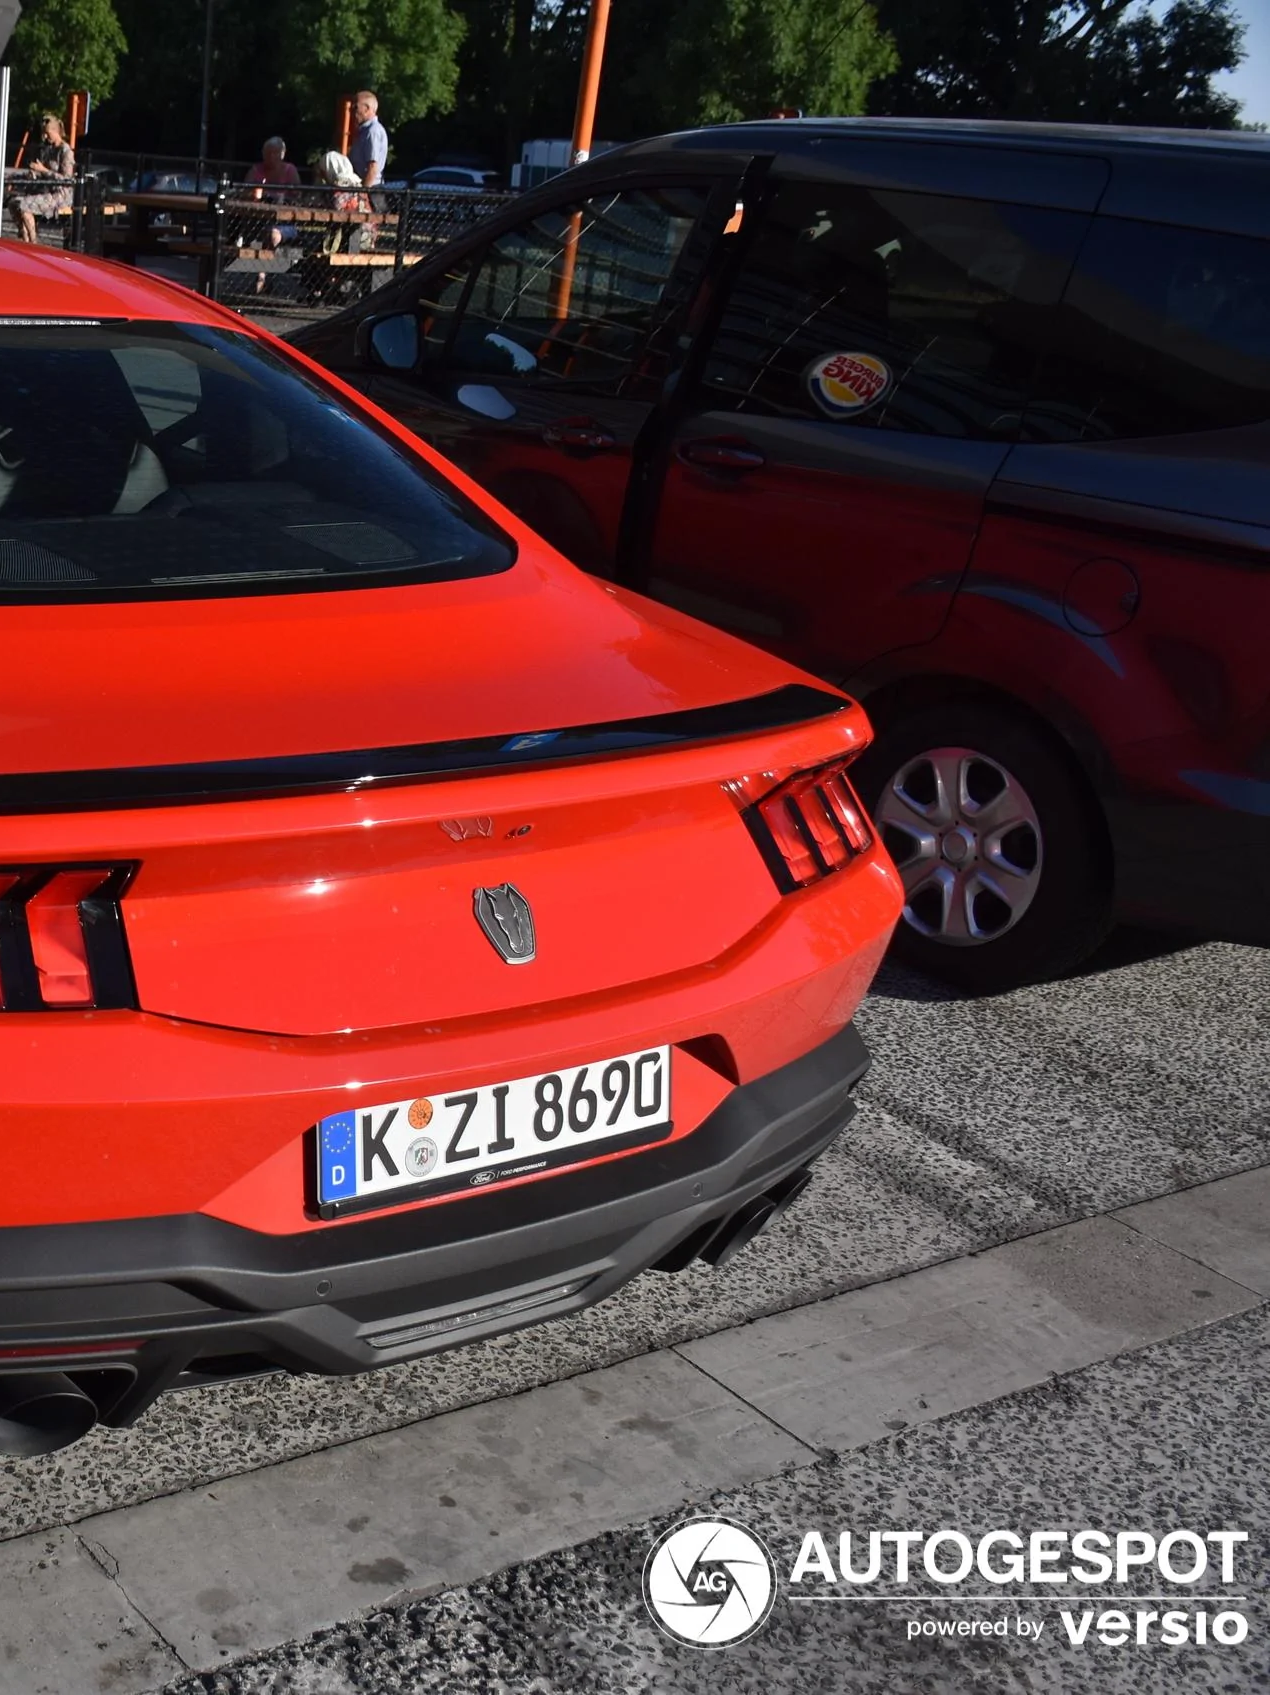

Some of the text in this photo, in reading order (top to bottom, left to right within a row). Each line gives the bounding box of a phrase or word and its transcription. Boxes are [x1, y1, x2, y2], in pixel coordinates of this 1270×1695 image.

[362, 1107, 399, 1182] K
[444, 1085, 514, 1164] ZI
[533, 1051, 663, 1142] 8690
[332, 1165, 345, 1186] D
[473, 1172, 492, 1184] Ford
